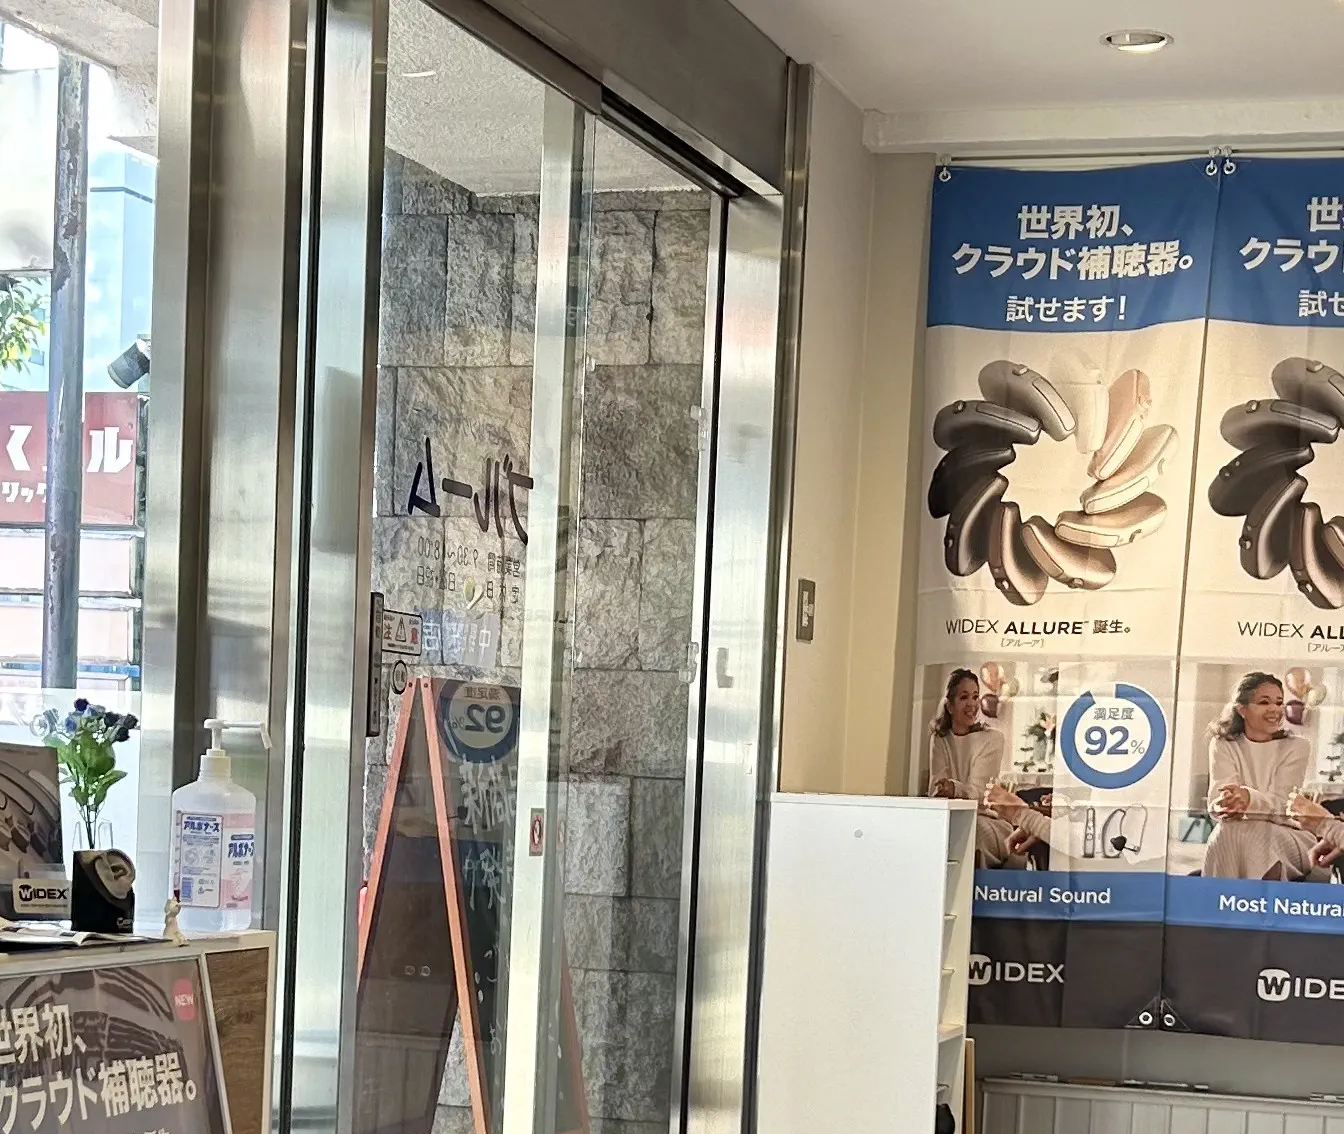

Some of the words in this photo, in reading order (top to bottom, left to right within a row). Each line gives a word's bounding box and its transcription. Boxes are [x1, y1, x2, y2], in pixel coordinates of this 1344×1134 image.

[1018, 204, 1134, 240] 世界初、
[952, 239, 1194, 280] クラウド補聴器。
[1006, 295, 1127, 323] 試せます！
[945, 618, 999, 636] WIDEX
[1004, 620, 1084, 635] ALLURE
[1093, 619, 1131, 635] 誕生。
[1237, 620, 1304, 639] WIDEX
[1093, 707, 1135, 721] 満足度
[18, 884, 69, 902] WIDEX
[974, 885, 1043, 903] Natural
[1049, 887, 1111, 904] Sound
[1219, 894, 1268, 914] Most
[967, 954, 1065, 985] WIDEX
